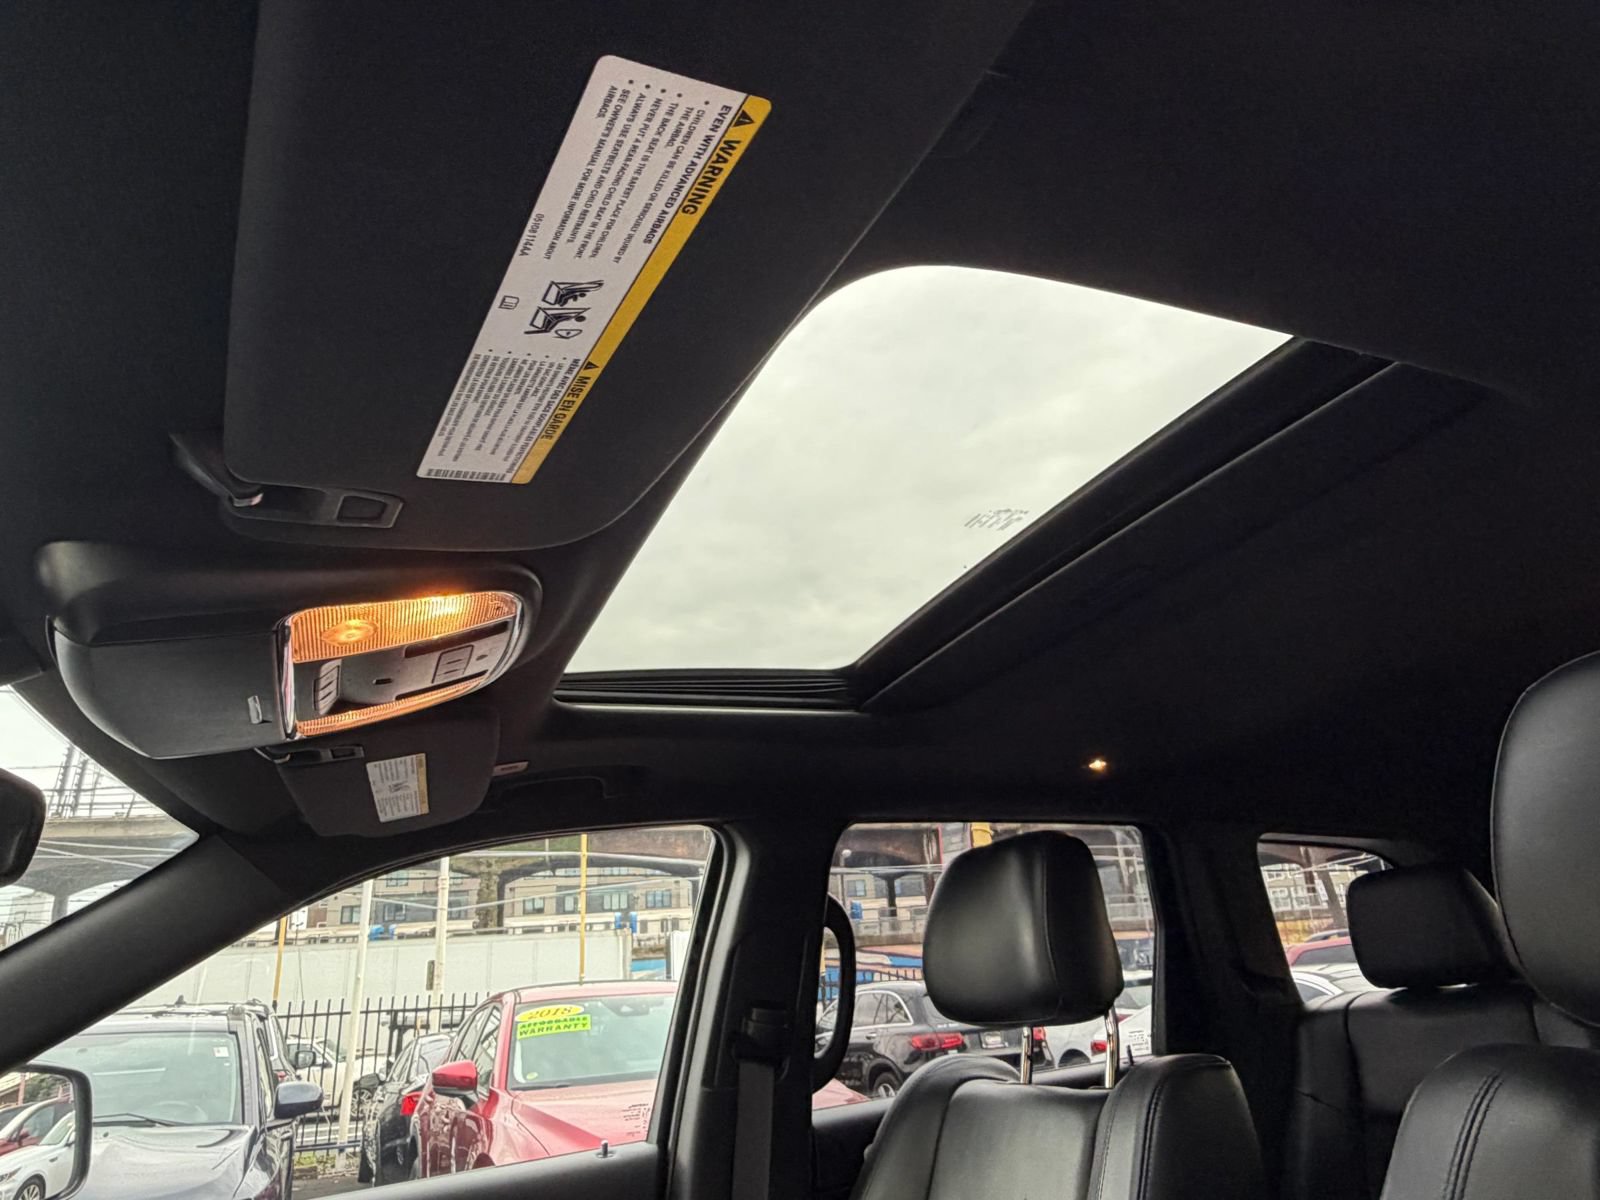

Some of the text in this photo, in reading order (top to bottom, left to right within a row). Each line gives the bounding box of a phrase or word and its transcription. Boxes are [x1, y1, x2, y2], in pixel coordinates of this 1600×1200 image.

[625, 92, 648, 123] ALWAYS
[643, 97, 664, 123] NEVER
[664, 102, 679, 116] THE
[679, 105, 694, 121] THE
[617, 123, 632, 138] USE
[635, 123, 650, 137] PUT
[653, 117, 671, 136] BACK
[679, 108, 706, 145] CHILDREN
[644, 136, 660, 154] SEAT
[670, 145, 685, 160] CAN
[599, 138, 625, 174] SEATBELTS
[610, 144, 639, 186] REAR-FACING
[640, 154, 650, 162] IS
[541, 88, 631, 259] SEE OWNER'S MANUAL FOR MORE INFORMATION ABOUT
[632, 162, 646, 175] THE
[641, 104, 732, 244] EVEN WITH ADVANCED AIRBAGS
[679, 137, 741, 215] WARNING
[592, 174, 606, 189] AND
[620, 175, 639, 198] SAFEST
[652, 169, 671, 191] KILLED
[582, 189, 599, 208] CHILD
[600, 186, 617, 206] CHILD
[646, 192, 658, 201] OR
[592, 206, 607, 220] SEAT
[610, 199, 626, 217] PLACE
[629, 202, 652, 232] SERIOUSLY
[603, 218, 616, 230] FOR
[582, 228, 595, 239] THE
[555, 375, 570, 389] AVEC
[565, 375, 591, 398] MISE
[557, 399, 576, 411] EN
[540, 412, 568, 440] GARDE
[527, 1006, 573, 1020] 2018
[519, 1022, 588, 1037] WARRANTY
